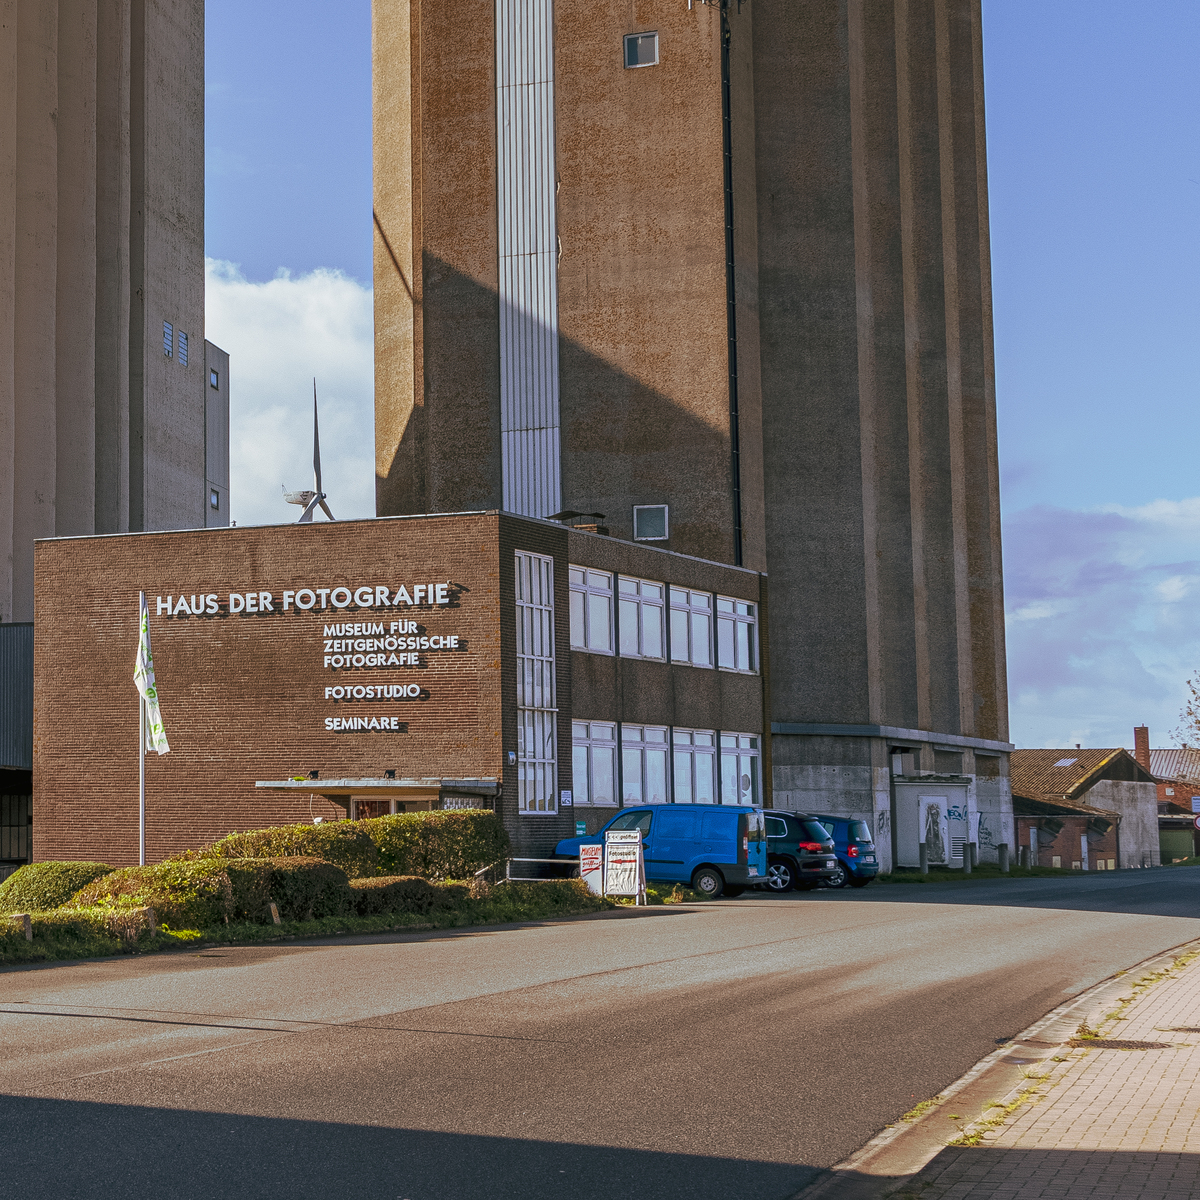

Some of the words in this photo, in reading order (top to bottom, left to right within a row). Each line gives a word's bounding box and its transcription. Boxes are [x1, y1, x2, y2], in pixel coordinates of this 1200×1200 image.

[156, 593, 219, 616] HAUS
[229, 591, 274, 613] DER
[282, 583, 450, 611] FOTOGRAFIE
[323, 621, 385, 637] MUSEUM
[390, 619, 418, 634] FÜR
[323, 634, 459, 653] ZEITGENÖSSISCHE
[323, 652, 420, 668] FOTOGRAFIE
[324, 683, 421, 700] FOTOSTUDIO
[324, 716, 399, 731] SEMINARE
